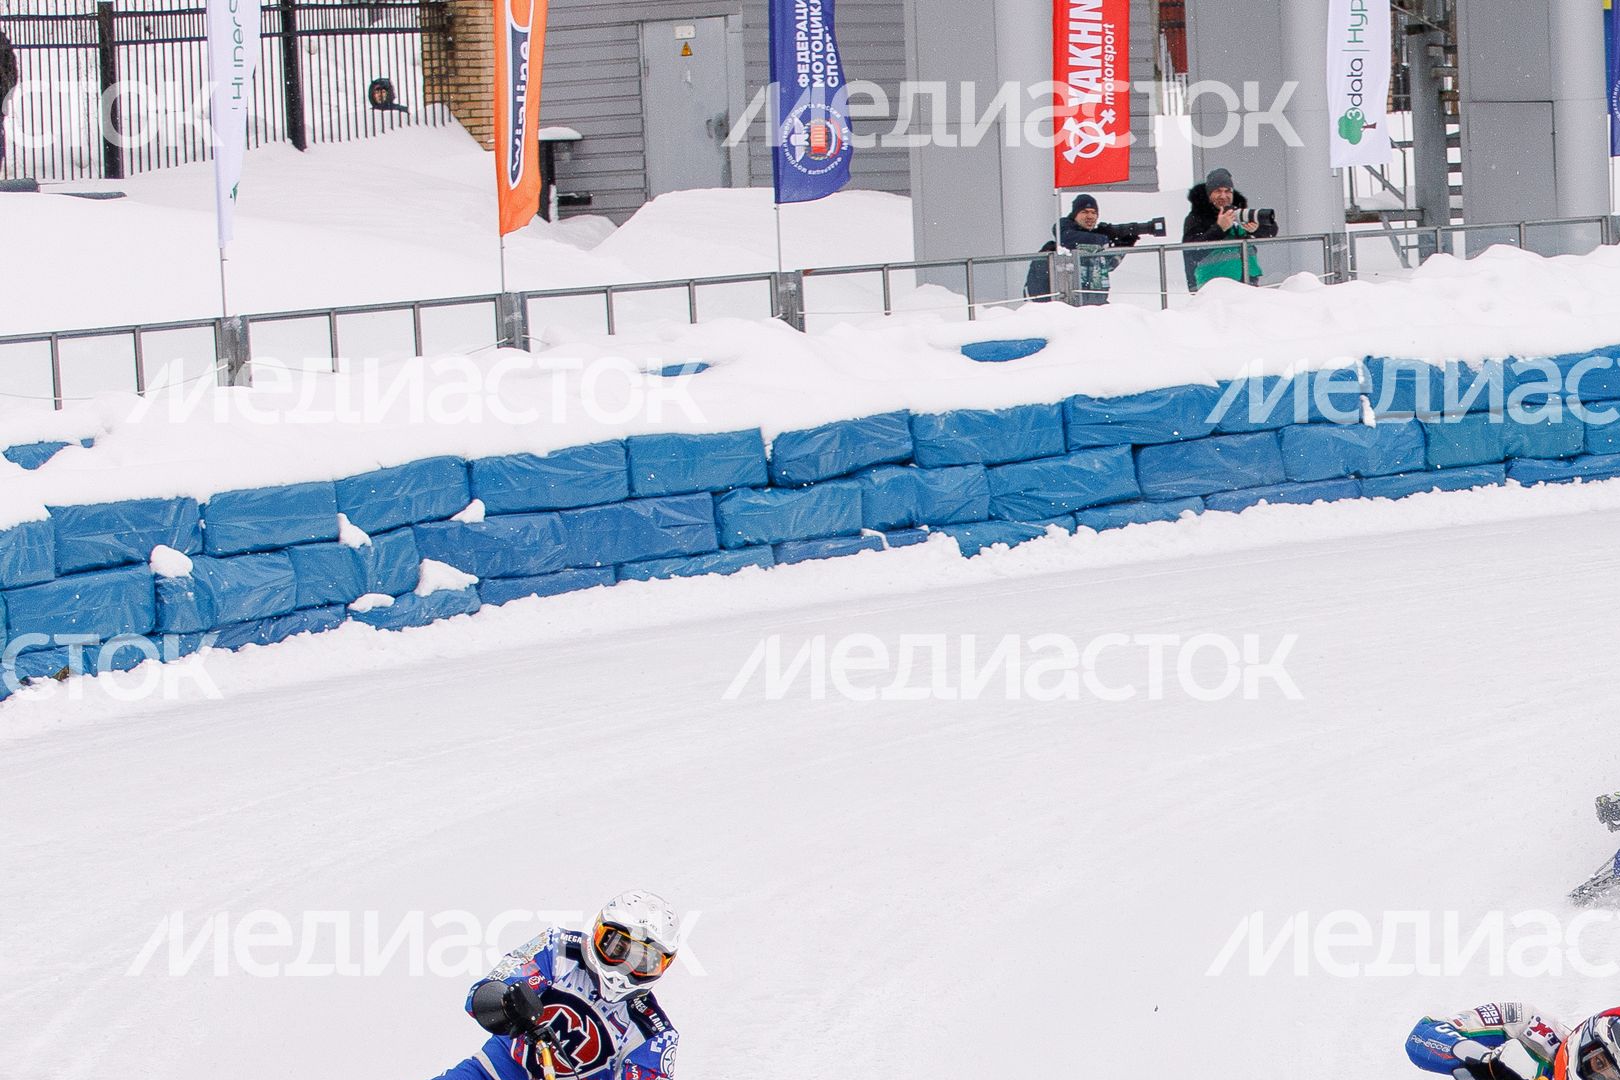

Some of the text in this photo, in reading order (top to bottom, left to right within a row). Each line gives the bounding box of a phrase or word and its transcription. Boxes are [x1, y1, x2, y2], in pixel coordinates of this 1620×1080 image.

[825, 26, 839, 88] СПОРТ
[1103, 23, 1117, 105] motorsport
[649, 1014, 666, 1032] LADA
